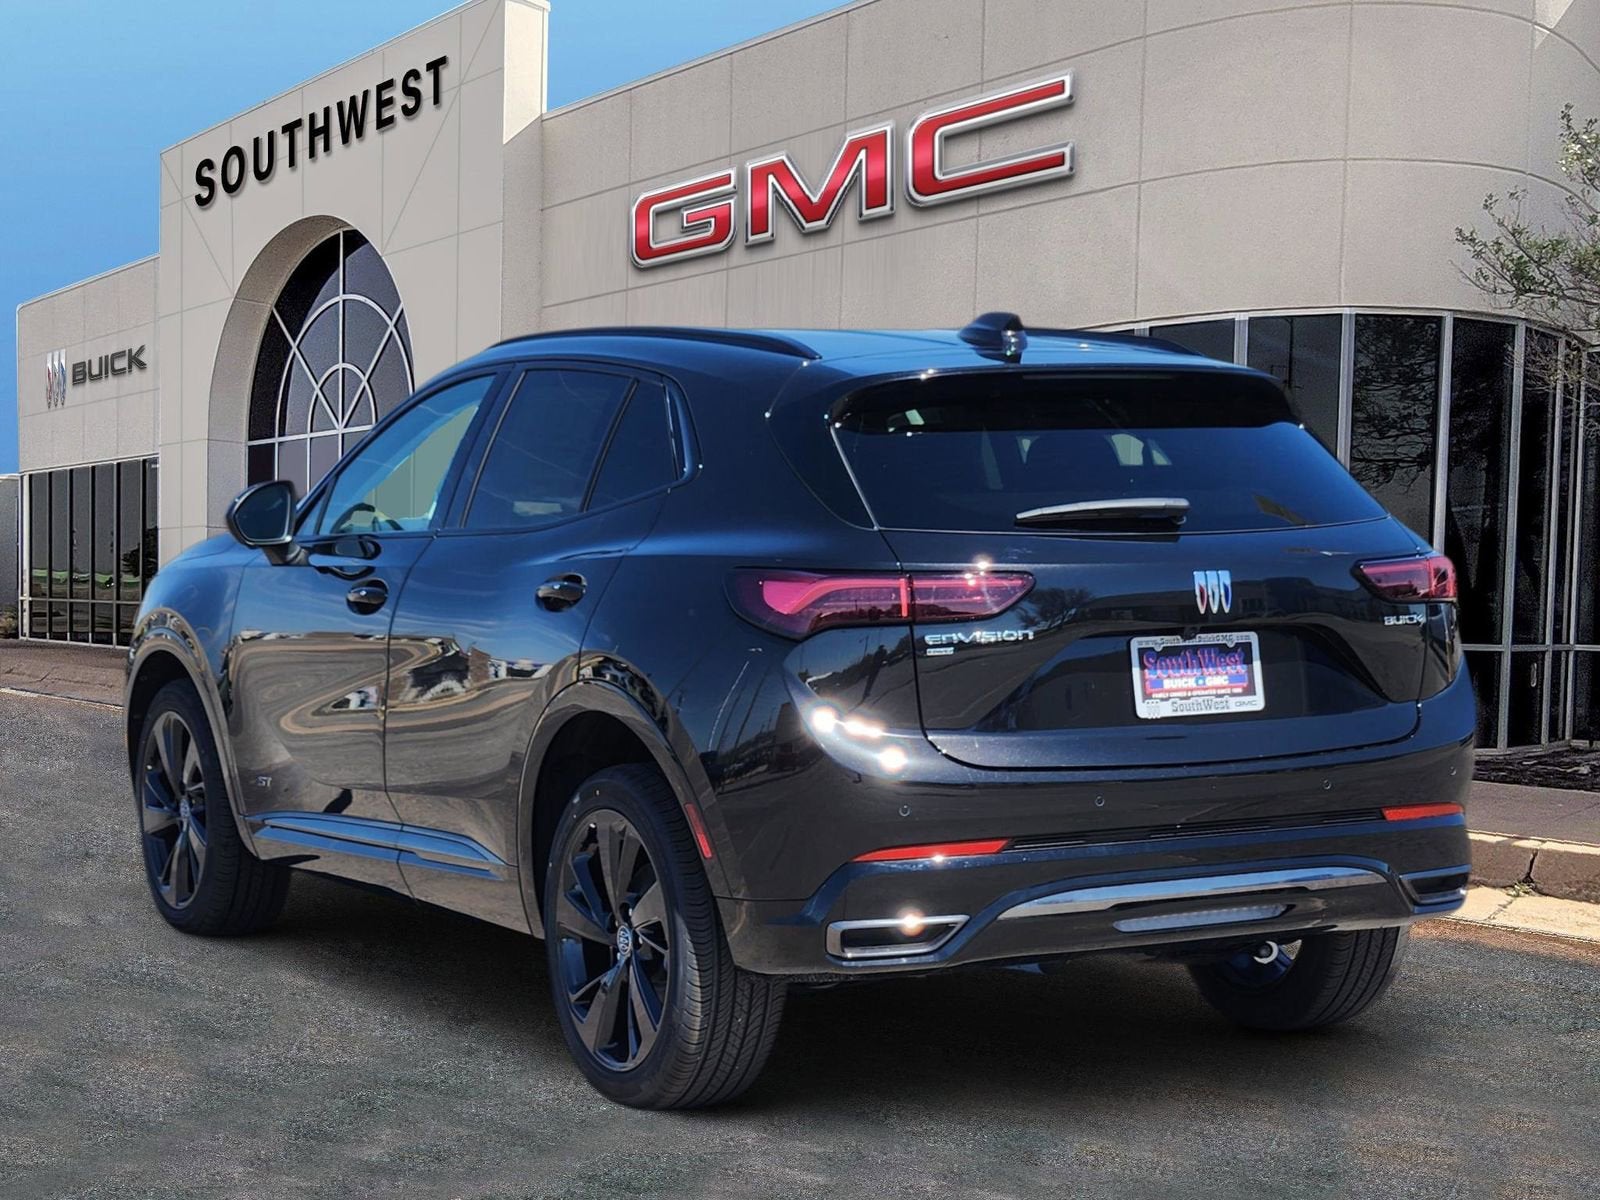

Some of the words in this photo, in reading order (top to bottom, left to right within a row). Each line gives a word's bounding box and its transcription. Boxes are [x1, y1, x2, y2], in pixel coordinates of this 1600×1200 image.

[194, 55, 448, 207] SOUTHWEST
[631, 69, 1075, 269] GMC
[72, 344, 147, 386] BUICK
[1384, 613, 1424, 626] BUICK
[924, 629, 1035, 645] ENVISION
[1143, 647, 1247, 678] SouthWest
[1163, 677, 1196, 689] BUICK
[1205, 675, 1229, 686] GMC
[1171, 698, 1230, 713] SouthWest
